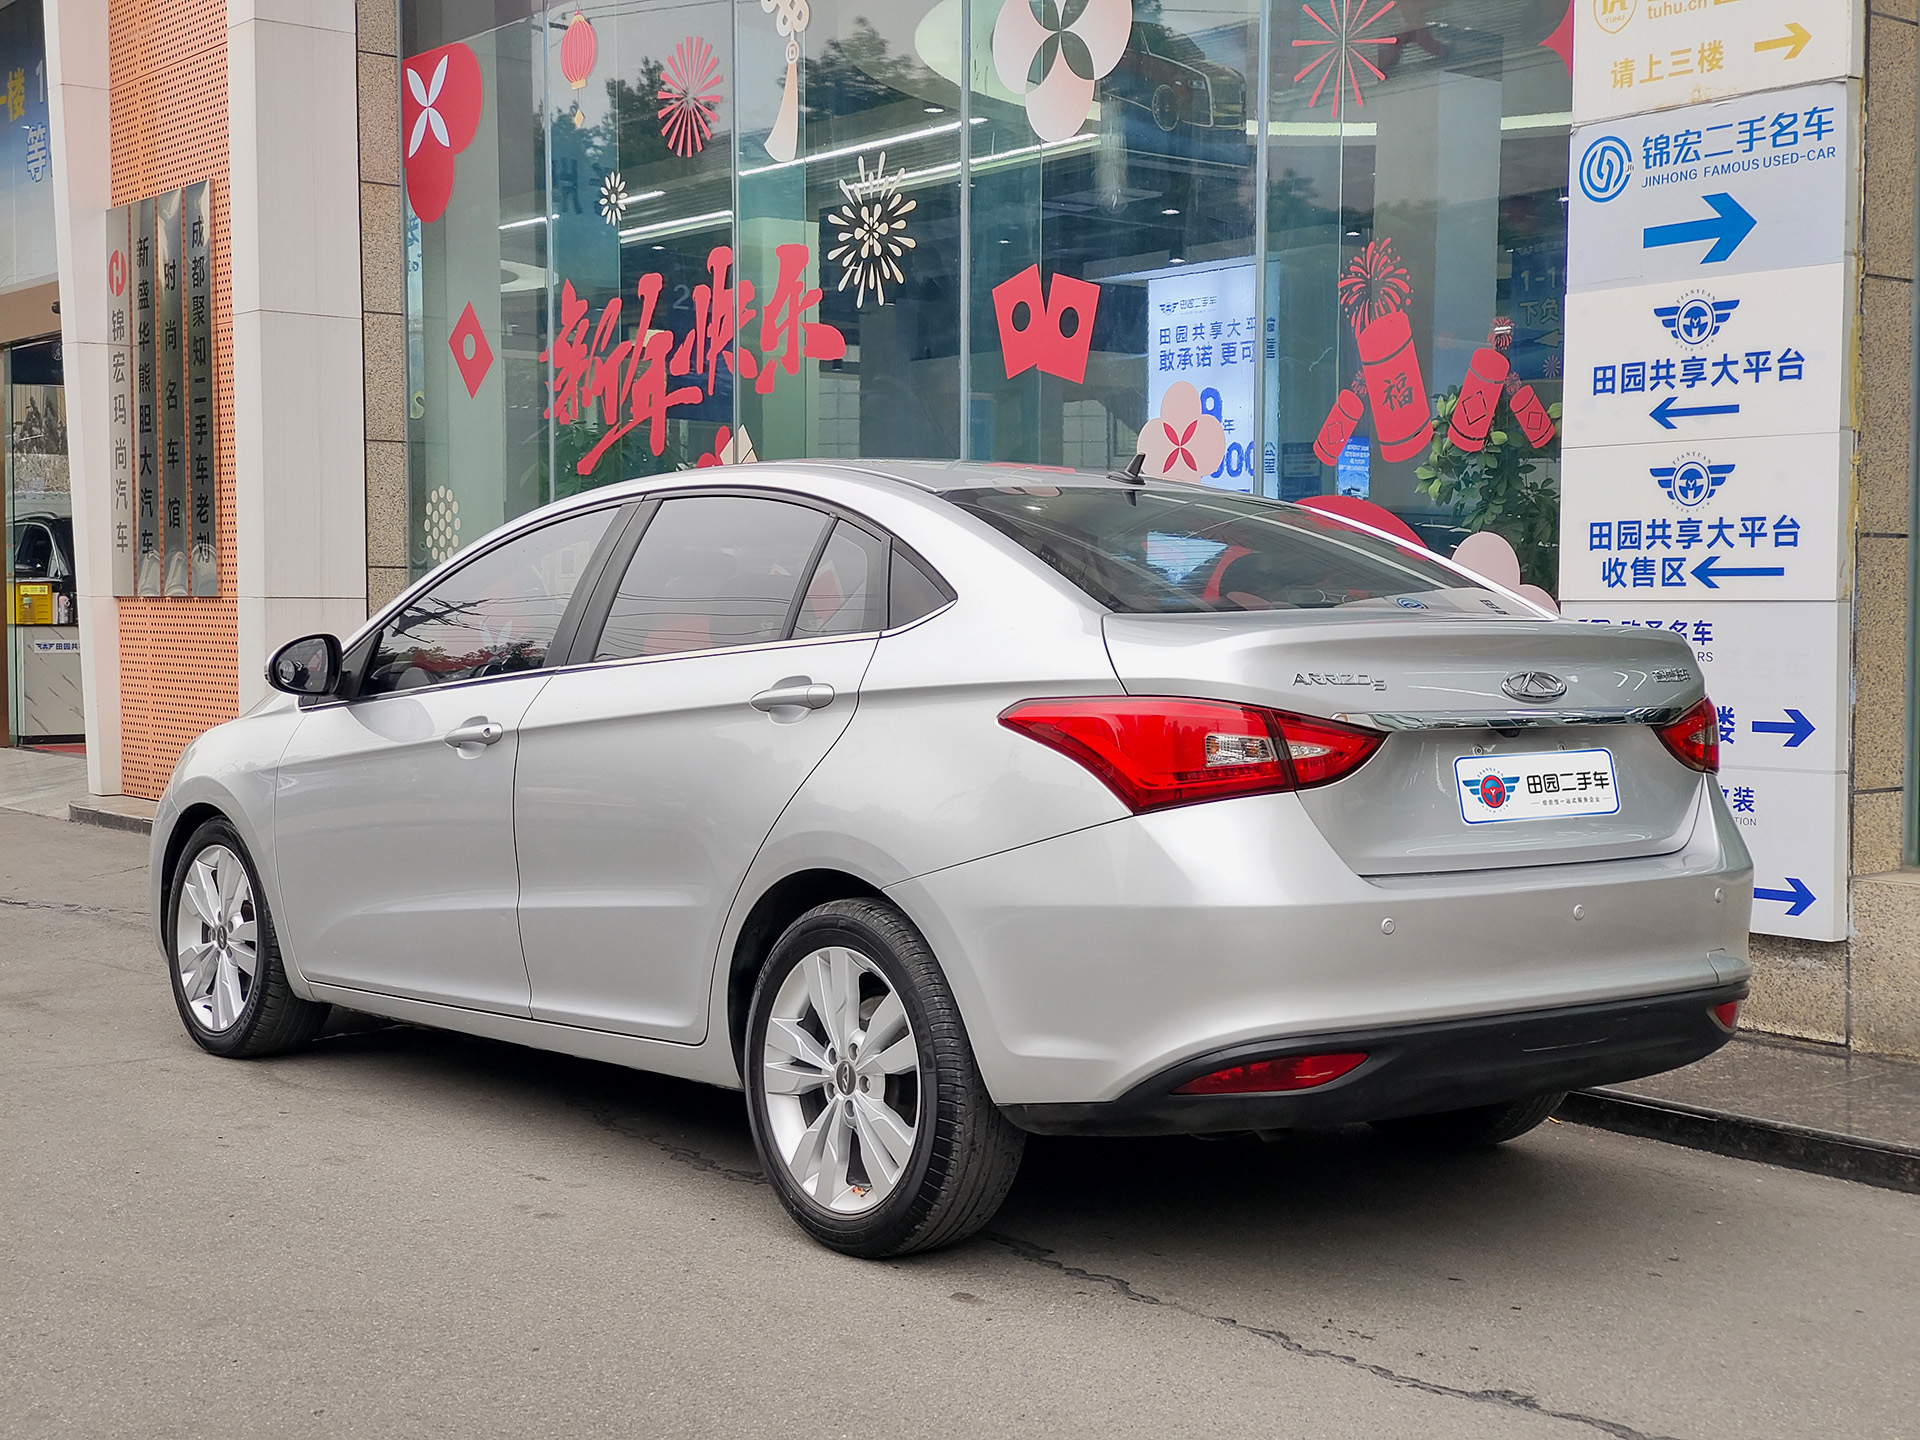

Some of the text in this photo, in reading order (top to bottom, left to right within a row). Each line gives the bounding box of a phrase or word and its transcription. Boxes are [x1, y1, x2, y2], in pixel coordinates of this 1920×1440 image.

[1647, 0, 1707, 20] tuhu.cn
[1610, 39, 1724, 90] 请上三楼
[1642, 106, 1834, 170] 锦宏二手名车
[1641, 146, 1836, 188] JINHONG FAMOUS USED-CAR
[539, 243, 846, 476] 新年快乐
[1592, 348, 1806, 396] 田园共享大平台
[136, 236, 155, 560] 新盛华熊胆大汽车
[164, 258, 181, 529] 时尚名车馆
[191, 215, 210, 564] 成都聚知二手车老刘
[1382, 372, 1414, 412] 福
[111, 308, 129, 554] 锦宏玛尚汽车
[1588, 514, 1801, 551] 田园共享大平台
[1601, 556, 1688, 589] 收售区
[1526, 770, 1610, 794] 田园二手车
